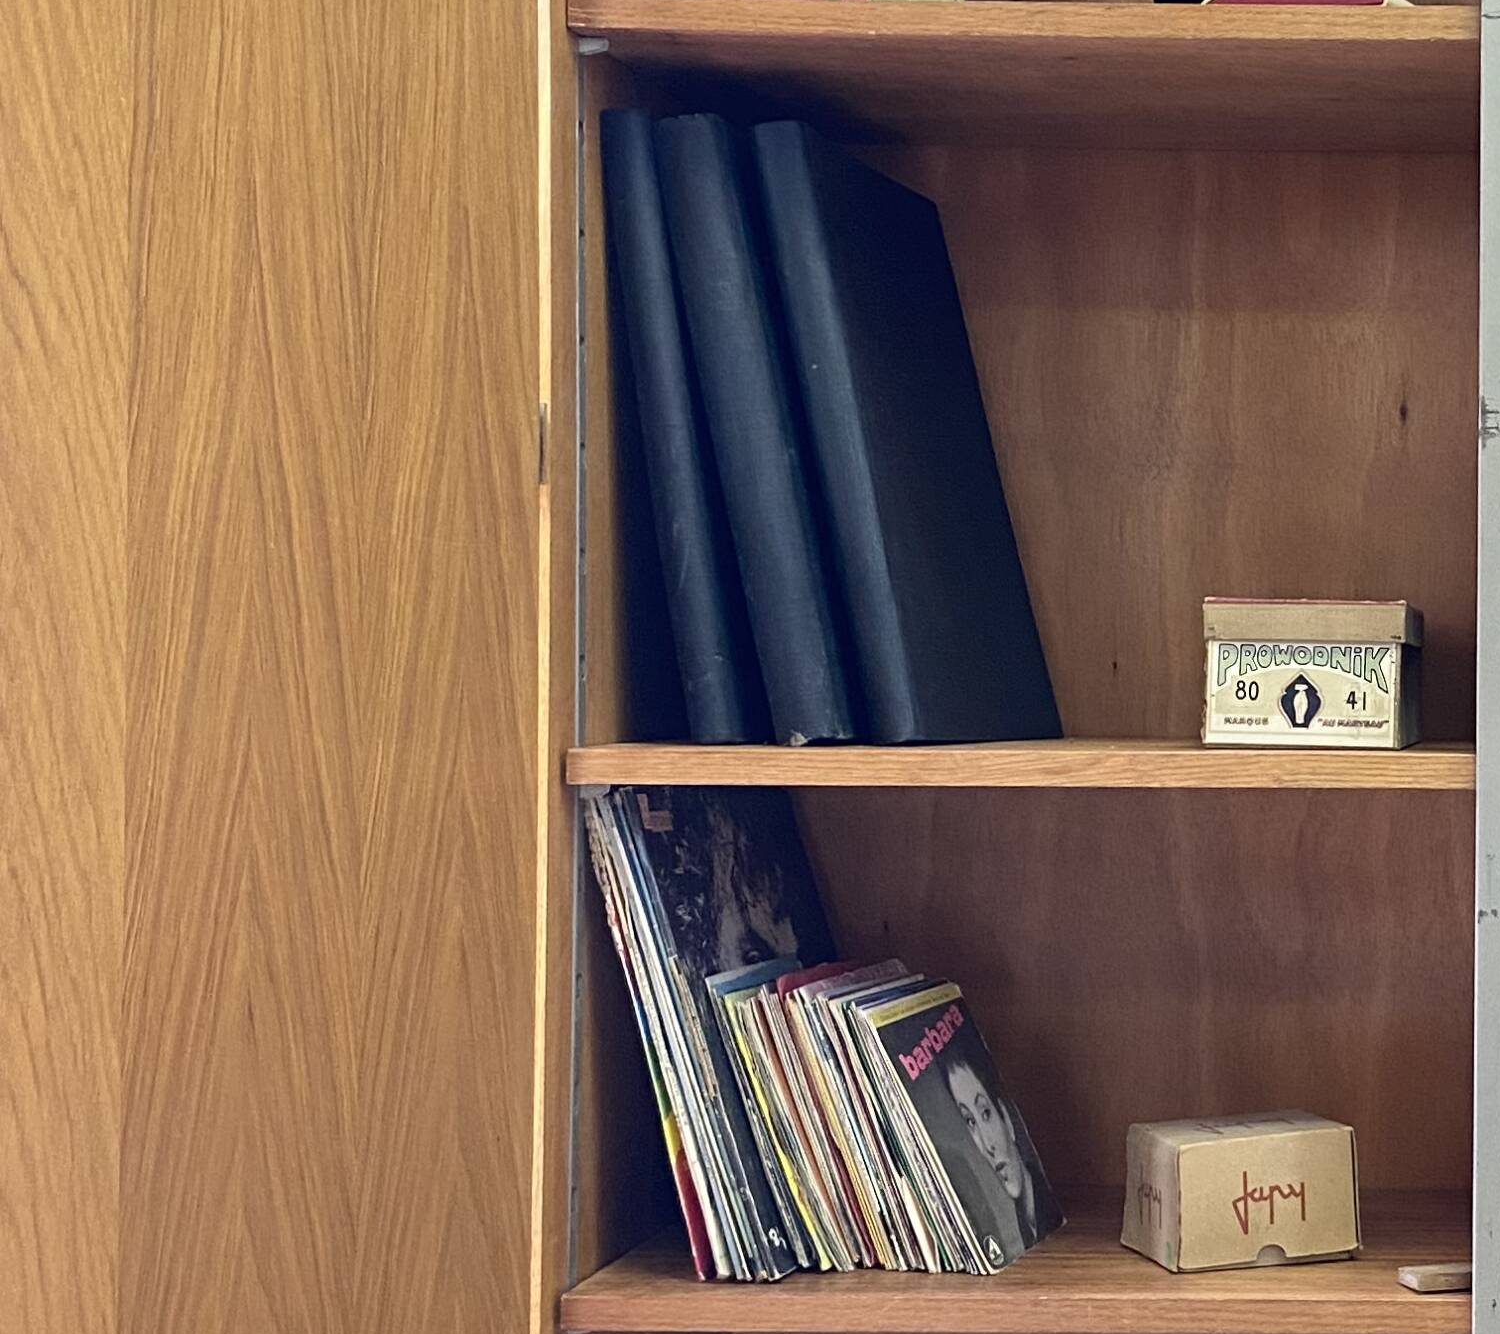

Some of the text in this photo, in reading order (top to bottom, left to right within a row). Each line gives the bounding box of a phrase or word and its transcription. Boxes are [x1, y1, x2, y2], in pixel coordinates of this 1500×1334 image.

[1235, 680, 1260, 701] 80
[1346, 690, 1367, 711] 41
[898, 1004, 964, 1081] barbara
